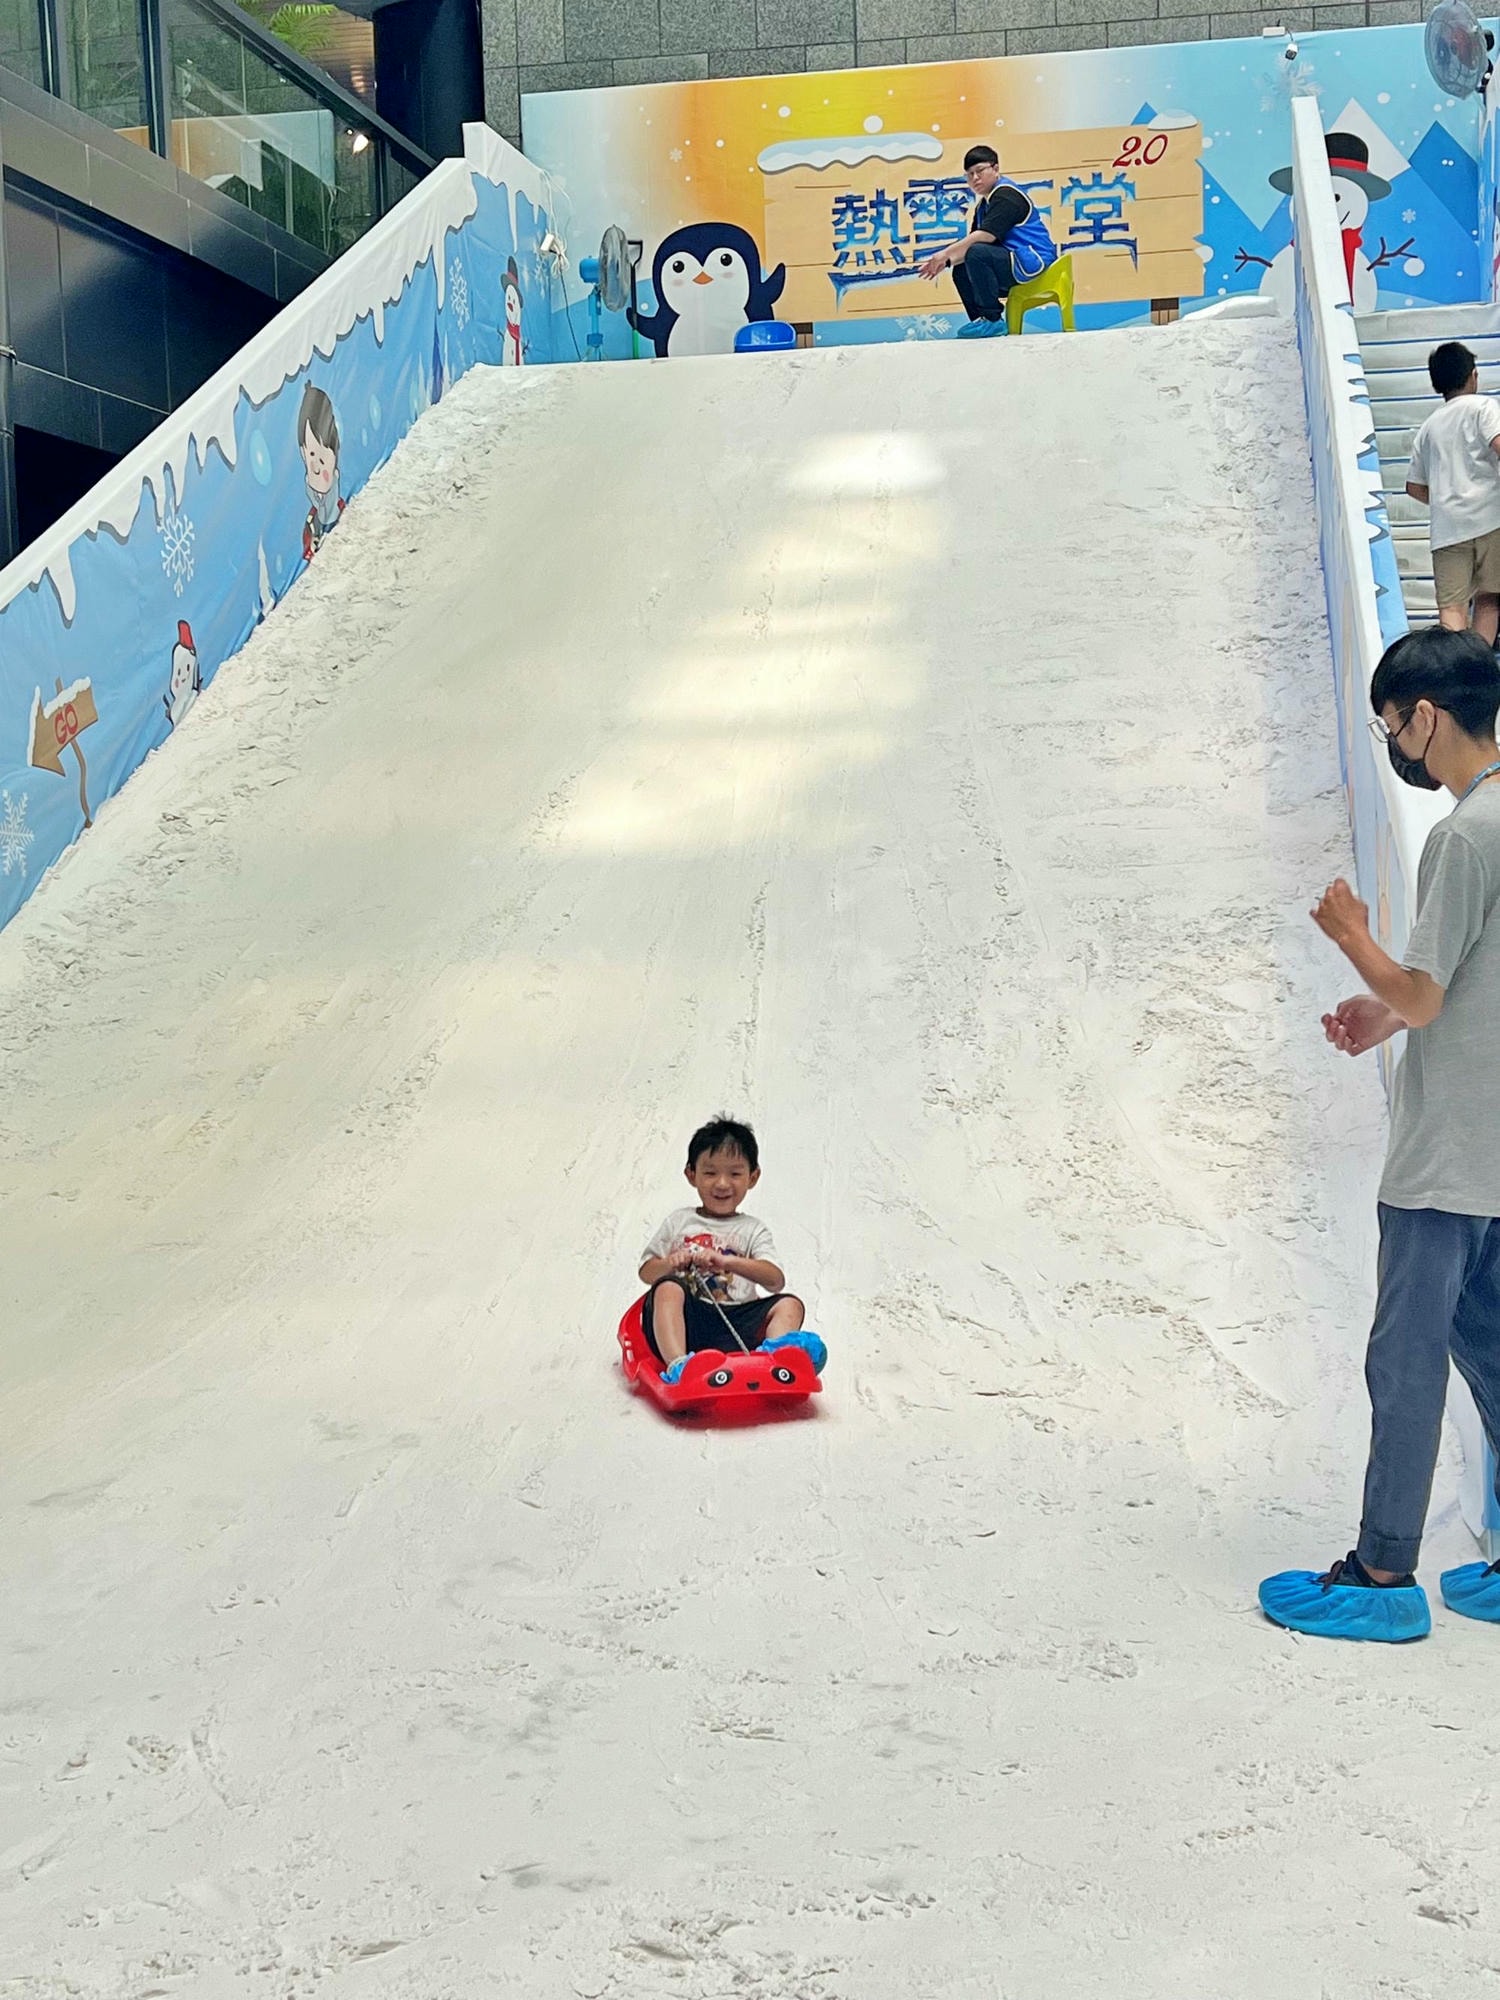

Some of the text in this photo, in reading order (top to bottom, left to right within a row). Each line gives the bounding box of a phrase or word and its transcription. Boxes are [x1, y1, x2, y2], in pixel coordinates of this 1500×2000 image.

[1112, 133, 1168, 167] 2.0
[827, 172, 1137, 302] 熱雪堂
[55, 703, 78, 744] GO
